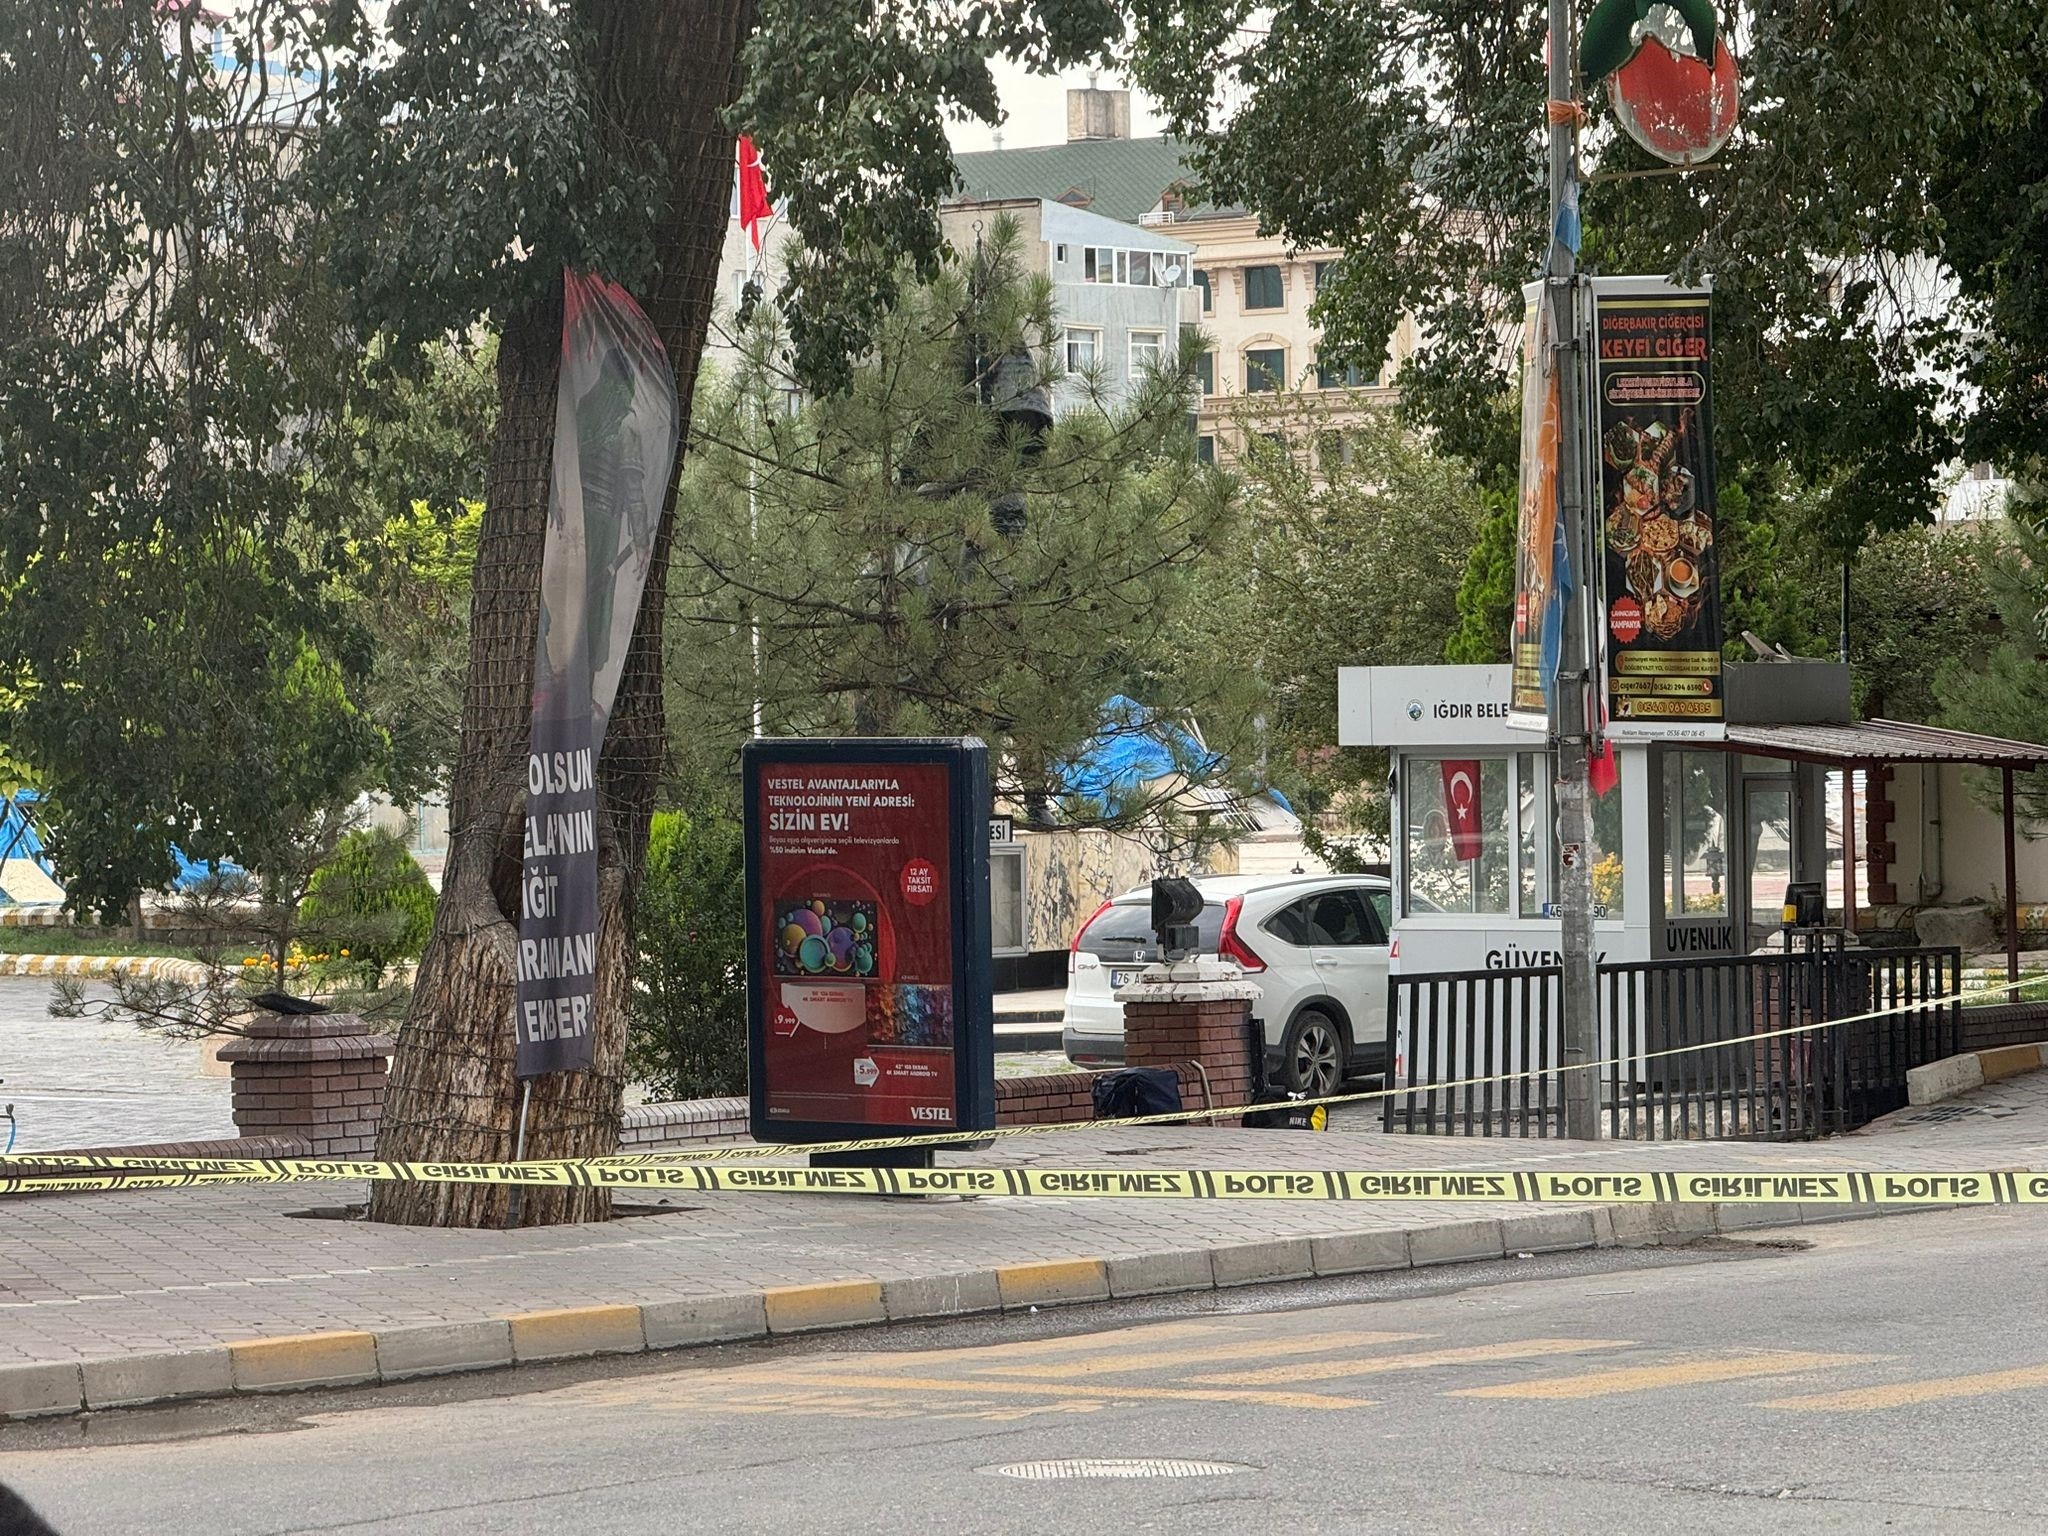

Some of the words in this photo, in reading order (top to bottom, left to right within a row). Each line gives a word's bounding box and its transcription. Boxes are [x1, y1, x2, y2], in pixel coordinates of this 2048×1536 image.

[1602, 335, 1651, 358] KEYFİ
[1655, 333, 1708, 361] CİĞER
[1611, 620, 1642, 629] KAMPANYA
[1433, 699, 1472, 718] IĞDIR
[1477, 703, 1509, 718] BELE
[1669, 702, 1686, 714] 969
[1687, 702, 1712, 714] 4385
[529, 747, 593, 795] OLSUN
[767, 778, 805, 790] VESTEL
[807, 779, 900, 790] AVANTAJLARIYLA
[767, 792, 843, 806] TEKNOLOJİNİN
[846, 793, 871, 807] YENİ
[872, 793, 915, 807] ADRESİ:
[769, 808, 815, 831] SİZİN
[820, 813, 850, 831] EV!
[784, 846, 807, 854] indirim
[910, 868, 918, 876] 12
[918, 868, 929, 877] AY
[907, 875, 931, 885] TAKSİT
[906, 885, 933, 893] FIRSATI
[1666, 920, 1732, 952] ÜVENLİK
[1117, 973, 1130, 984] 76
[910, 1106, 953, 1121] VESTEL
[1289, 1116, 1307, 1127] NIKE
